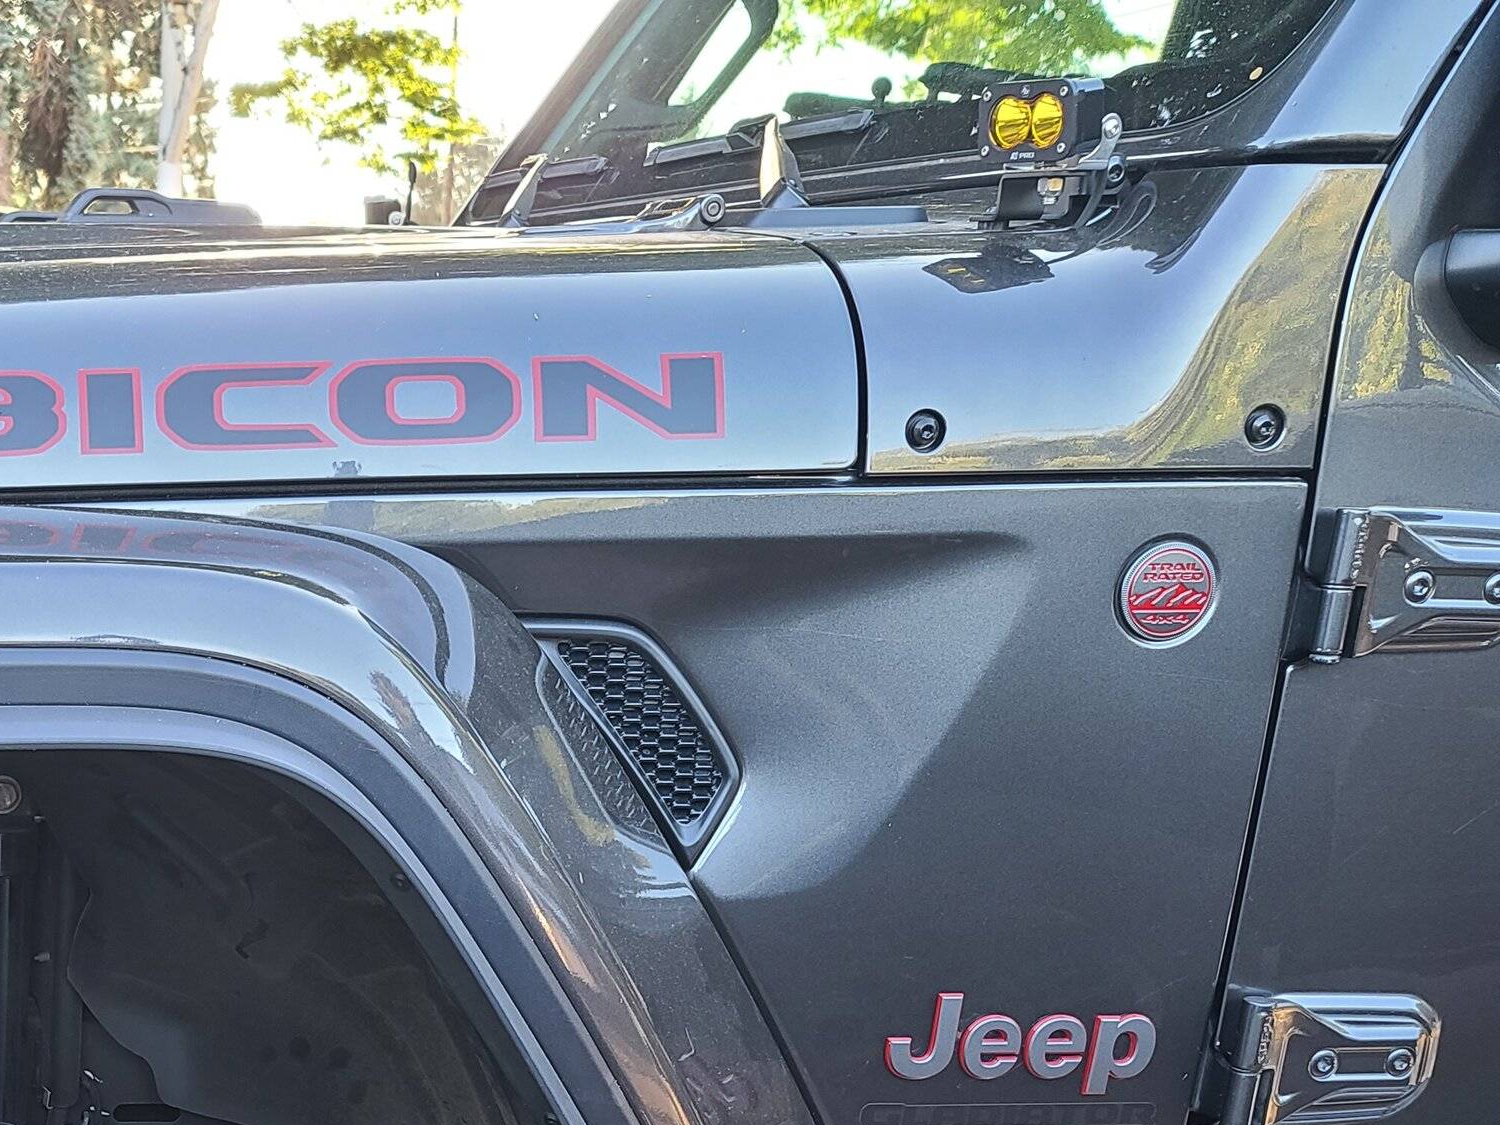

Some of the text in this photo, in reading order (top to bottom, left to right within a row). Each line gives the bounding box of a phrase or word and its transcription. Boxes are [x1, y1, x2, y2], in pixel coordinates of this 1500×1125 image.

[1148, 562, 1202, 573] TRAIL
[1142, 572, 1205, 583] RATED
[884, 992, 1157, 1095] Jeep
